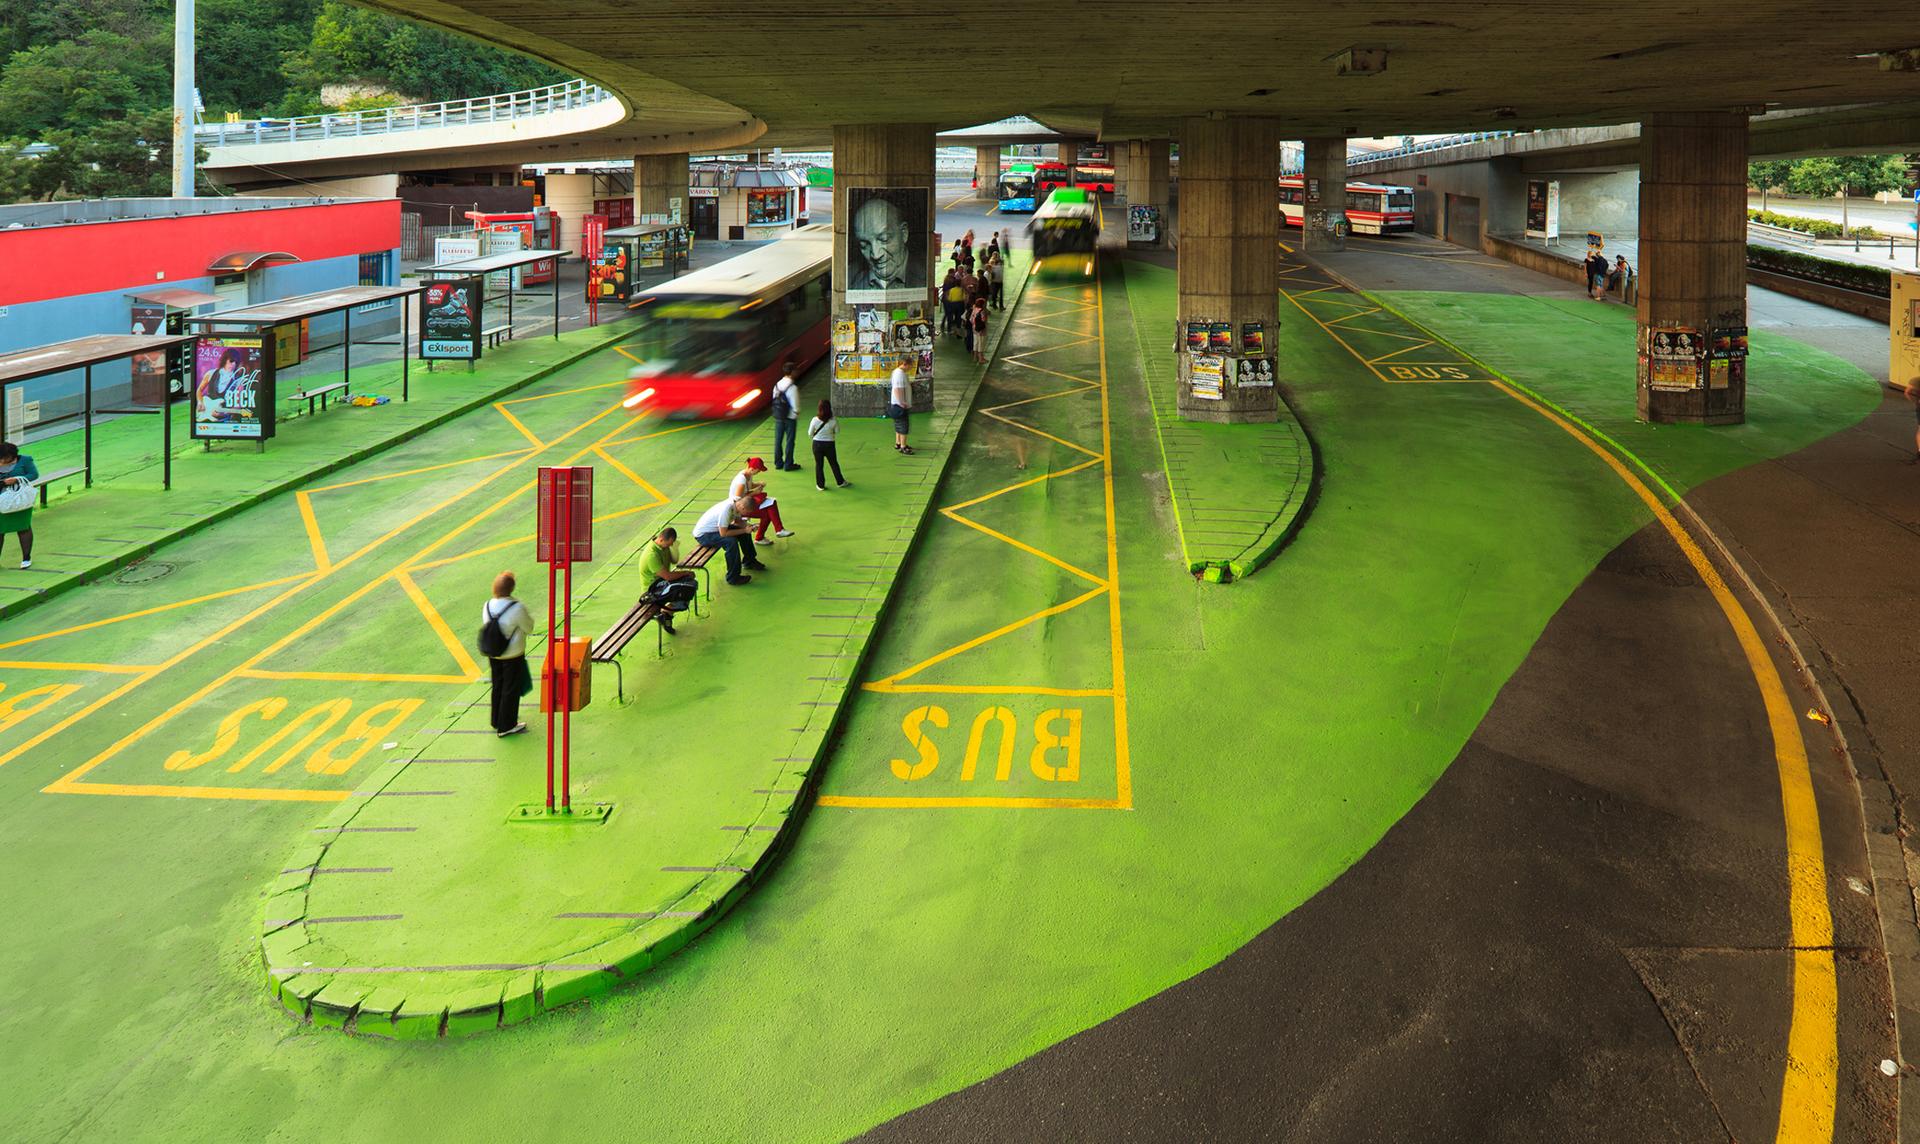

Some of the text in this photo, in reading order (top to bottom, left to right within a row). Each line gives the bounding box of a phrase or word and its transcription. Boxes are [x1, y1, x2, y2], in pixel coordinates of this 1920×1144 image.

[1388, 367, 1469, 379] BUS
[226, 389, 256, 408] BECK
[164, 696, 426, 775] BUS
[890, 704, 1083, 782] BUS
